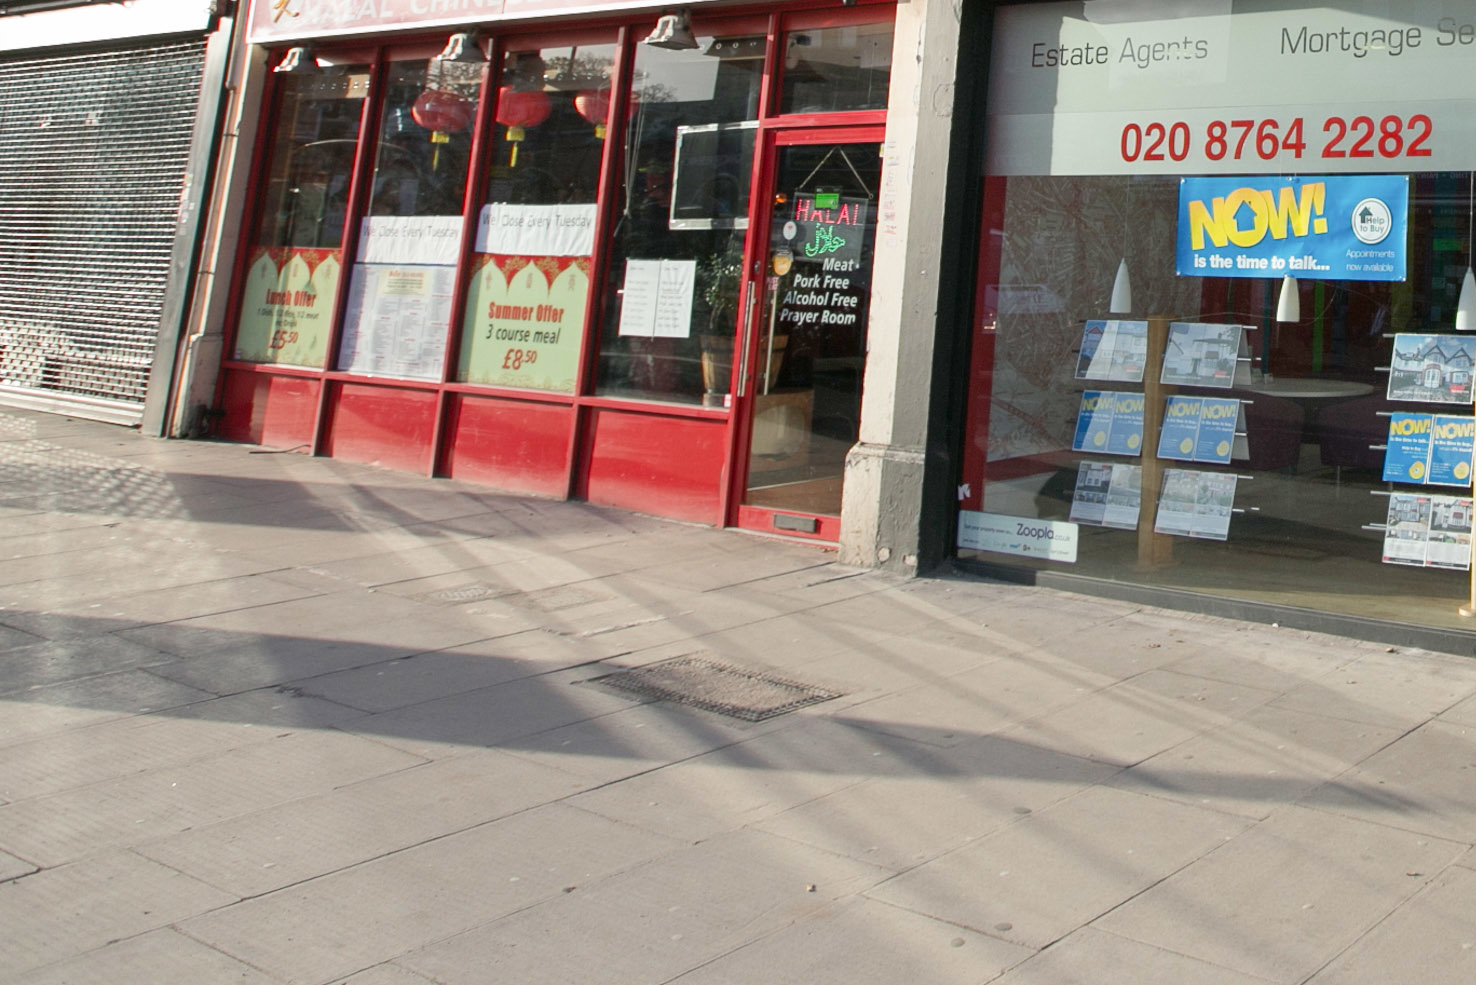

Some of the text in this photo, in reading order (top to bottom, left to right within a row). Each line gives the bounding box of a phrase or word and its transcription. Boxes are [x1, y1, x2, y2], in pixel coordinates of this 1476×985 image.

[1281, 26, 1421, 58] Mortgage
[1031, 35, 1208, 69] Estate Agents
[1120, 114, 1433, 162] 020 8764 2282
[483, 214, 592, 229] We Close Every Tuesday
[1189, 182, 1329, 251] NOW!
[1366, 216, 1386, 227] Help
[379, 226, 399, 237] Close
[402, 226, 423, 238] Every
[428, 226, 459, 239] Tuesday
[1359, 224, 1385, 234] to Buy
[1194, 254, 1330, 271] is the time to talk...
[1346, 249, 1395, 259] Appointments
[823, 258, 854, 272] Meat
[1346, 263, 1393, 272] now available
[793, 274, 820, 289] Pork
[823, 275, 850, 289] Free
[266, 289, 317, 307] Lunch Offer
[783, 291, 858, 307] Alcohol Free
[488, 302, 564, 323] Summer Offer
[780, 308, 856, 326] Prayer Room
[485, 324, 561, 344] 3 course meal
[502, 348, 538, 370] £8.50
[1167, 402, 1201, 417] NOW!
[1203, 404, 1236, 420] NOW!
[1390, 418, 1432, 436] NOW!
[1434, 422, 1475, 440] NOW!
